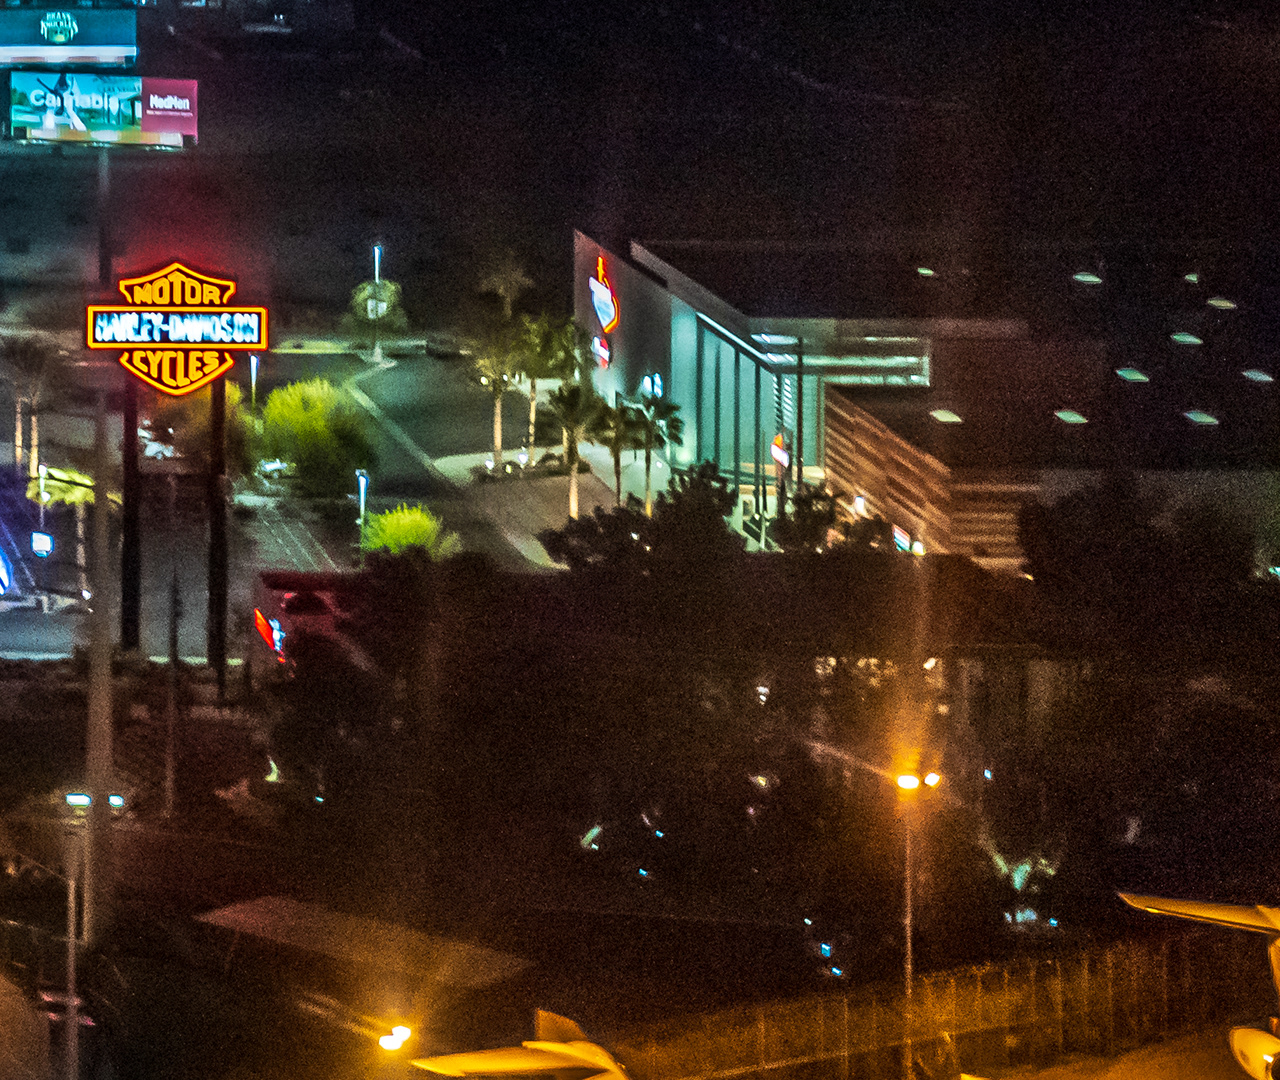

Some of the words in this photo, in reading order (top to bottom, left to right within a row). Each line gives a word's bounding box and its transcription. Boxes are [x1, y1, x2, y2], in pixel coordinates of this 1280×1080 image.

[133, 271, 221, 304] MOTOR
[95, 312, 259, 343] HARLEY-DAVIDSON
[132, 351, 220, 388] CYCLES
